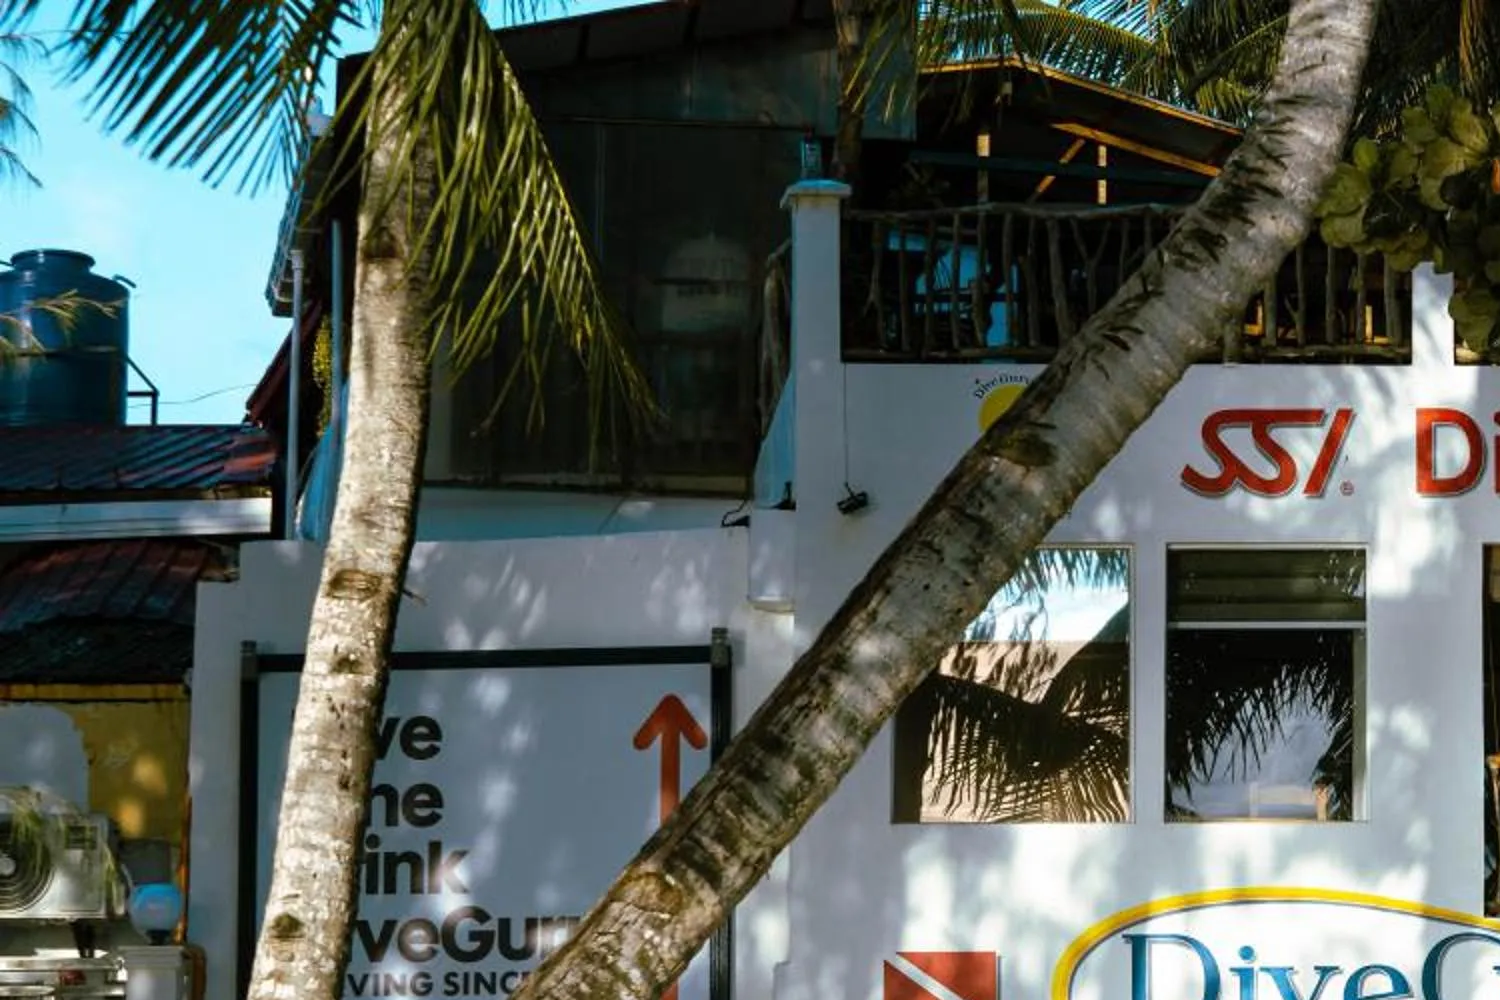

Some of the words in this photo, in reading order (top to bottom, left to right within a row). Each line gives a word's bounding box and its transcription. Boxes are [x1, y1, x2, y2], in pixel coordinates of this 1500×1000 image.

[1182, 407, 1353, 497] SSI
[366, 783, 445, 828] ne
[360, 833, 471, 896] ink
[348, 905, 582, 964] veGur
[342, 971, 434, 998] VING
[443, 970, 534, 998] SINC
